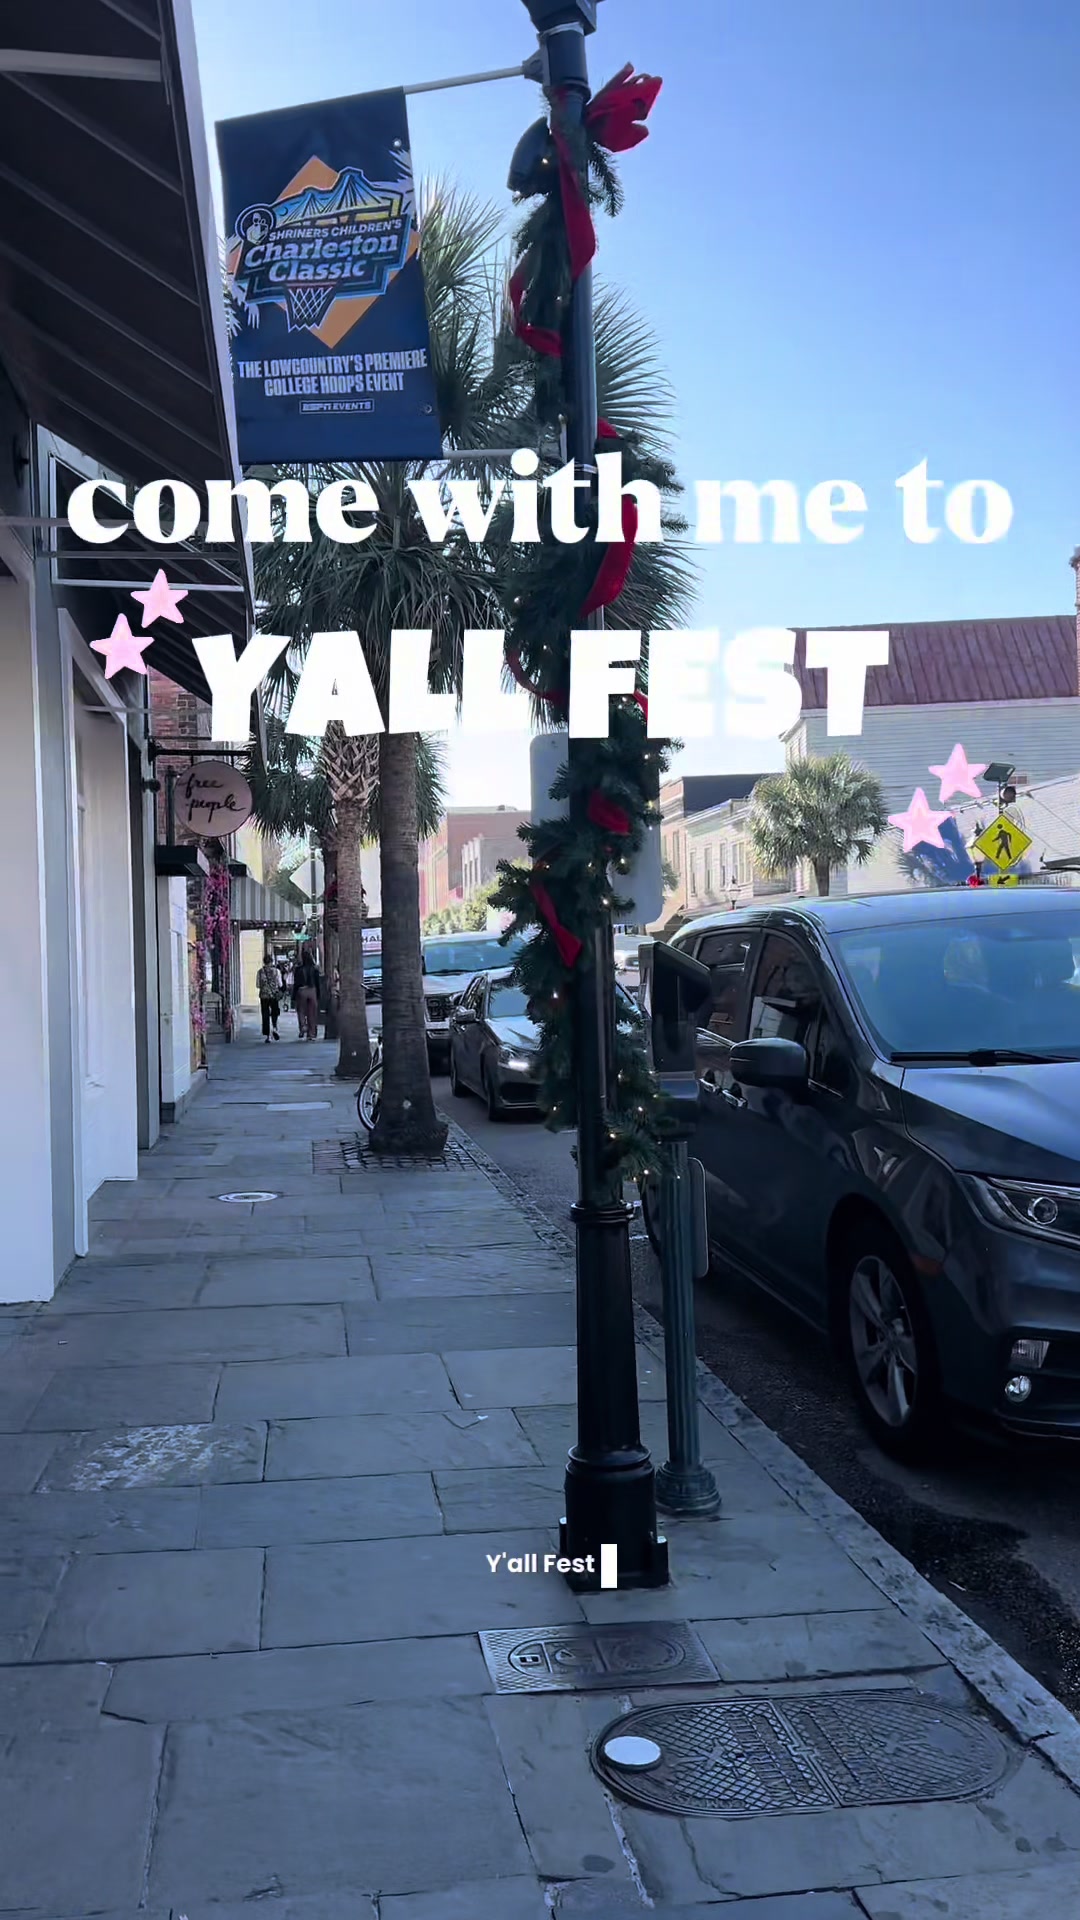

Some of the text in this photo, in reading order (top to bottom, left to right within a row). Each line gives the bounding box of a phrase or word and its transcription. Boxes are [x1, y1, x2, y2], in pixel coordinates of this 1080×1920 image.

[268, 218, 403, 242] SHRINERS CHILDREN'S
[244, 233, 399, 268] Charleston
[268, 256, 367, 283] Classic
[237, 348, 428, 378] THE LOWCOUNTRY'S PREMIERE
[264, 370, 405, 397] COLLEGE HOOPS EVENT
[332, 400, 372, 411] EVENTS
[177, 772, 247, 824] free people
